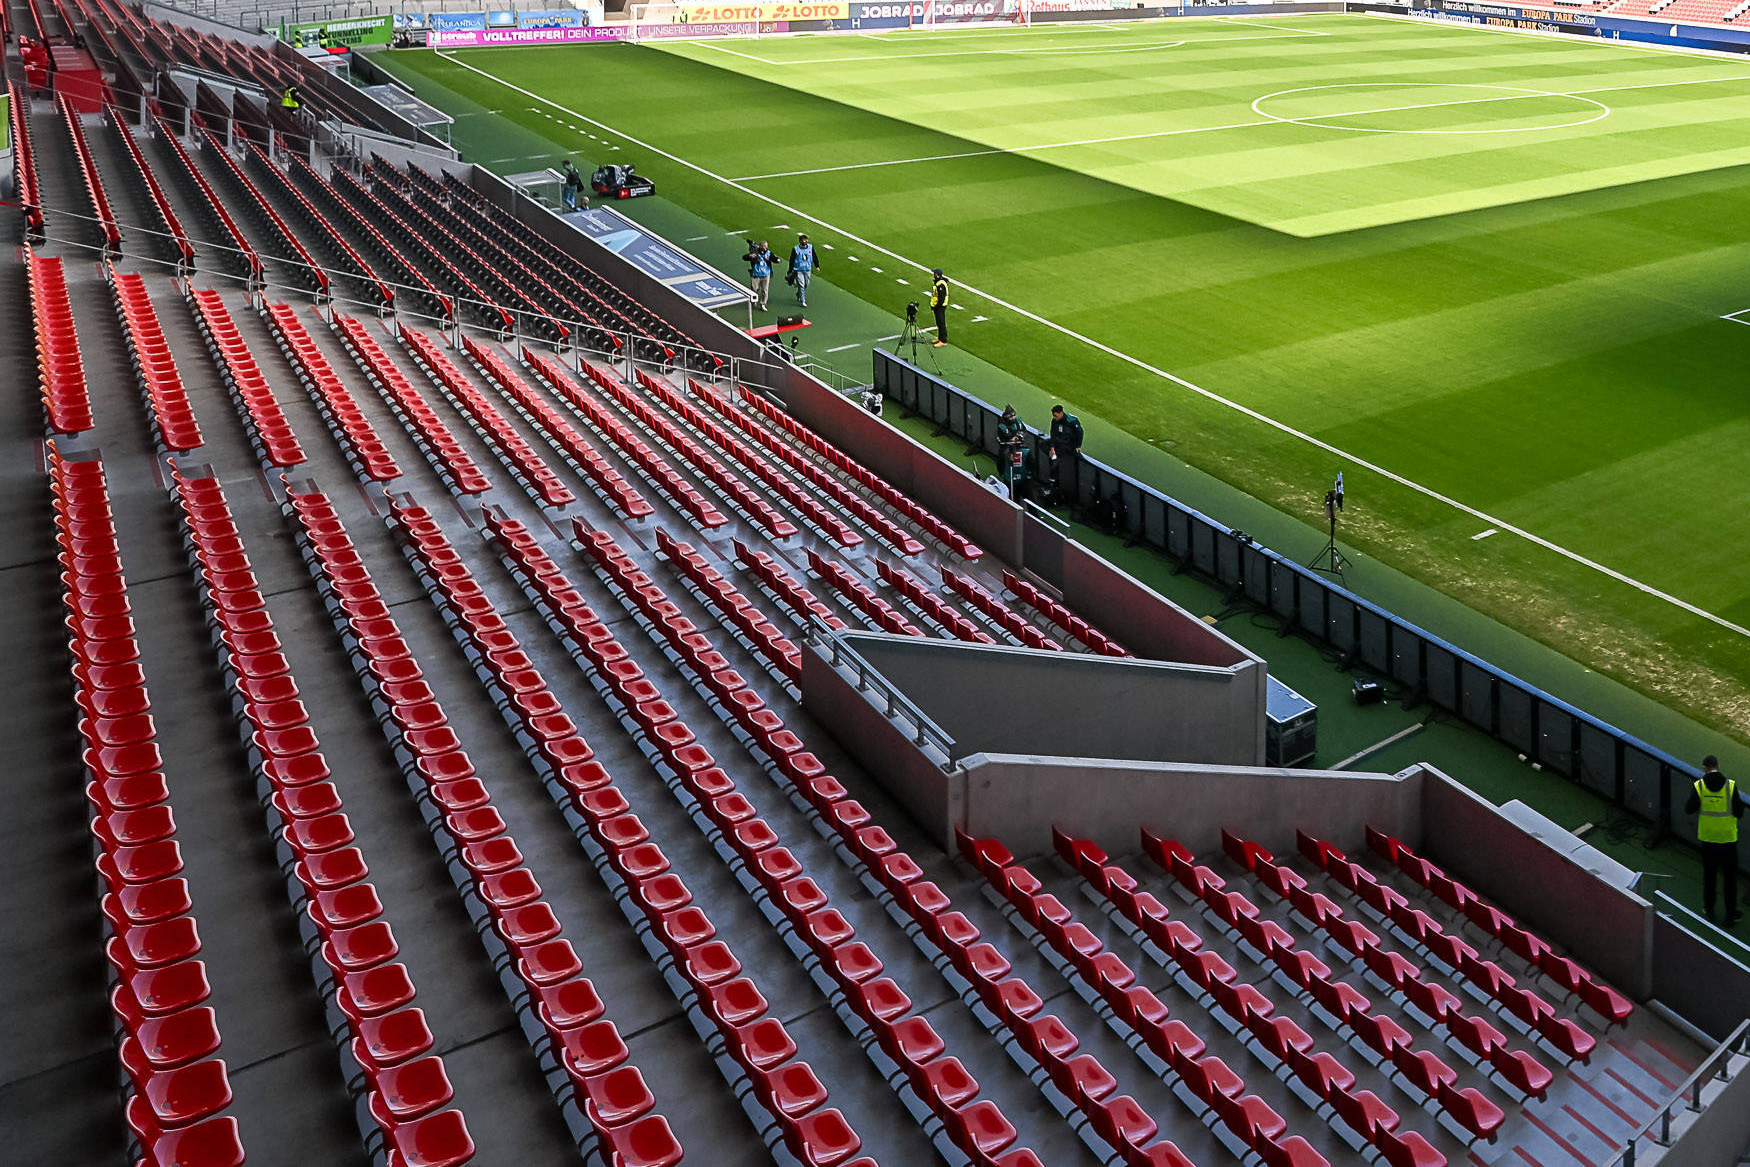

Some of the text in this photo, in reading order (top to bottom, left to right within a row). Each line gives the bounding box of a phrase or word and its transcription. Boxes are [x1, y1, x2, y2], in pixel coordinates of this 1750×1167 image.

[713, 6, 763, 20] LOTTO
[793, 5, 839, 18] LOTTO
[859, 2, 995, 19] JOBRAD JOBRAD
[1442, 0, 1596, 26] Herzlich willkommen im EUROPA PARK Stadion
[326, 18, 386, 30] HERRENKNECHT
[524, 17, 573, 26] EUROPA PARK
[1407, 7, 1560, 33] Herzlich willkommen im EUROPA PARK Stadion
[482, 29, 564, 42] VOLLTREFFER!
[567, 29, 592, 39] DEIN
[648, 24, 687, 35] UNSERE
